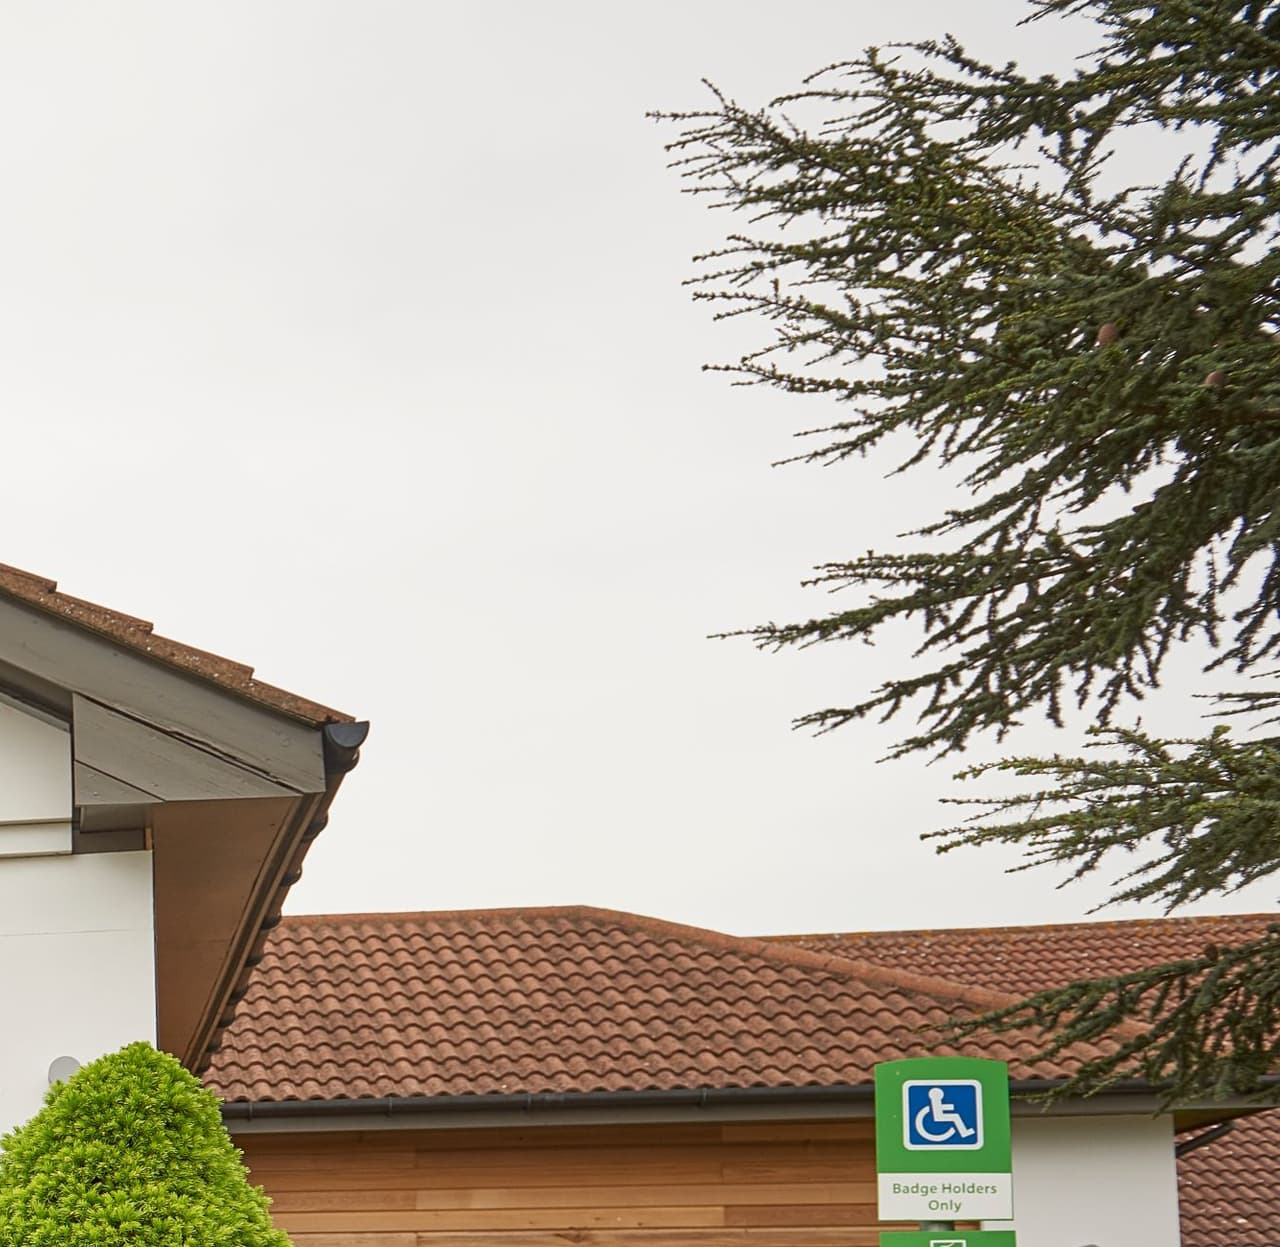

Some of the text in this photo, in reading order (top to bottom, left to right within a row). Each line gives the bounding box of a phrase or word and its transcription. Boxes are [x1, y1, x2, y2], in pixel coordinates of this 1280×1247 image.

[892, 1183, 997, 1196] Badge Holders
[928, 1200, 962, 1213] Only
